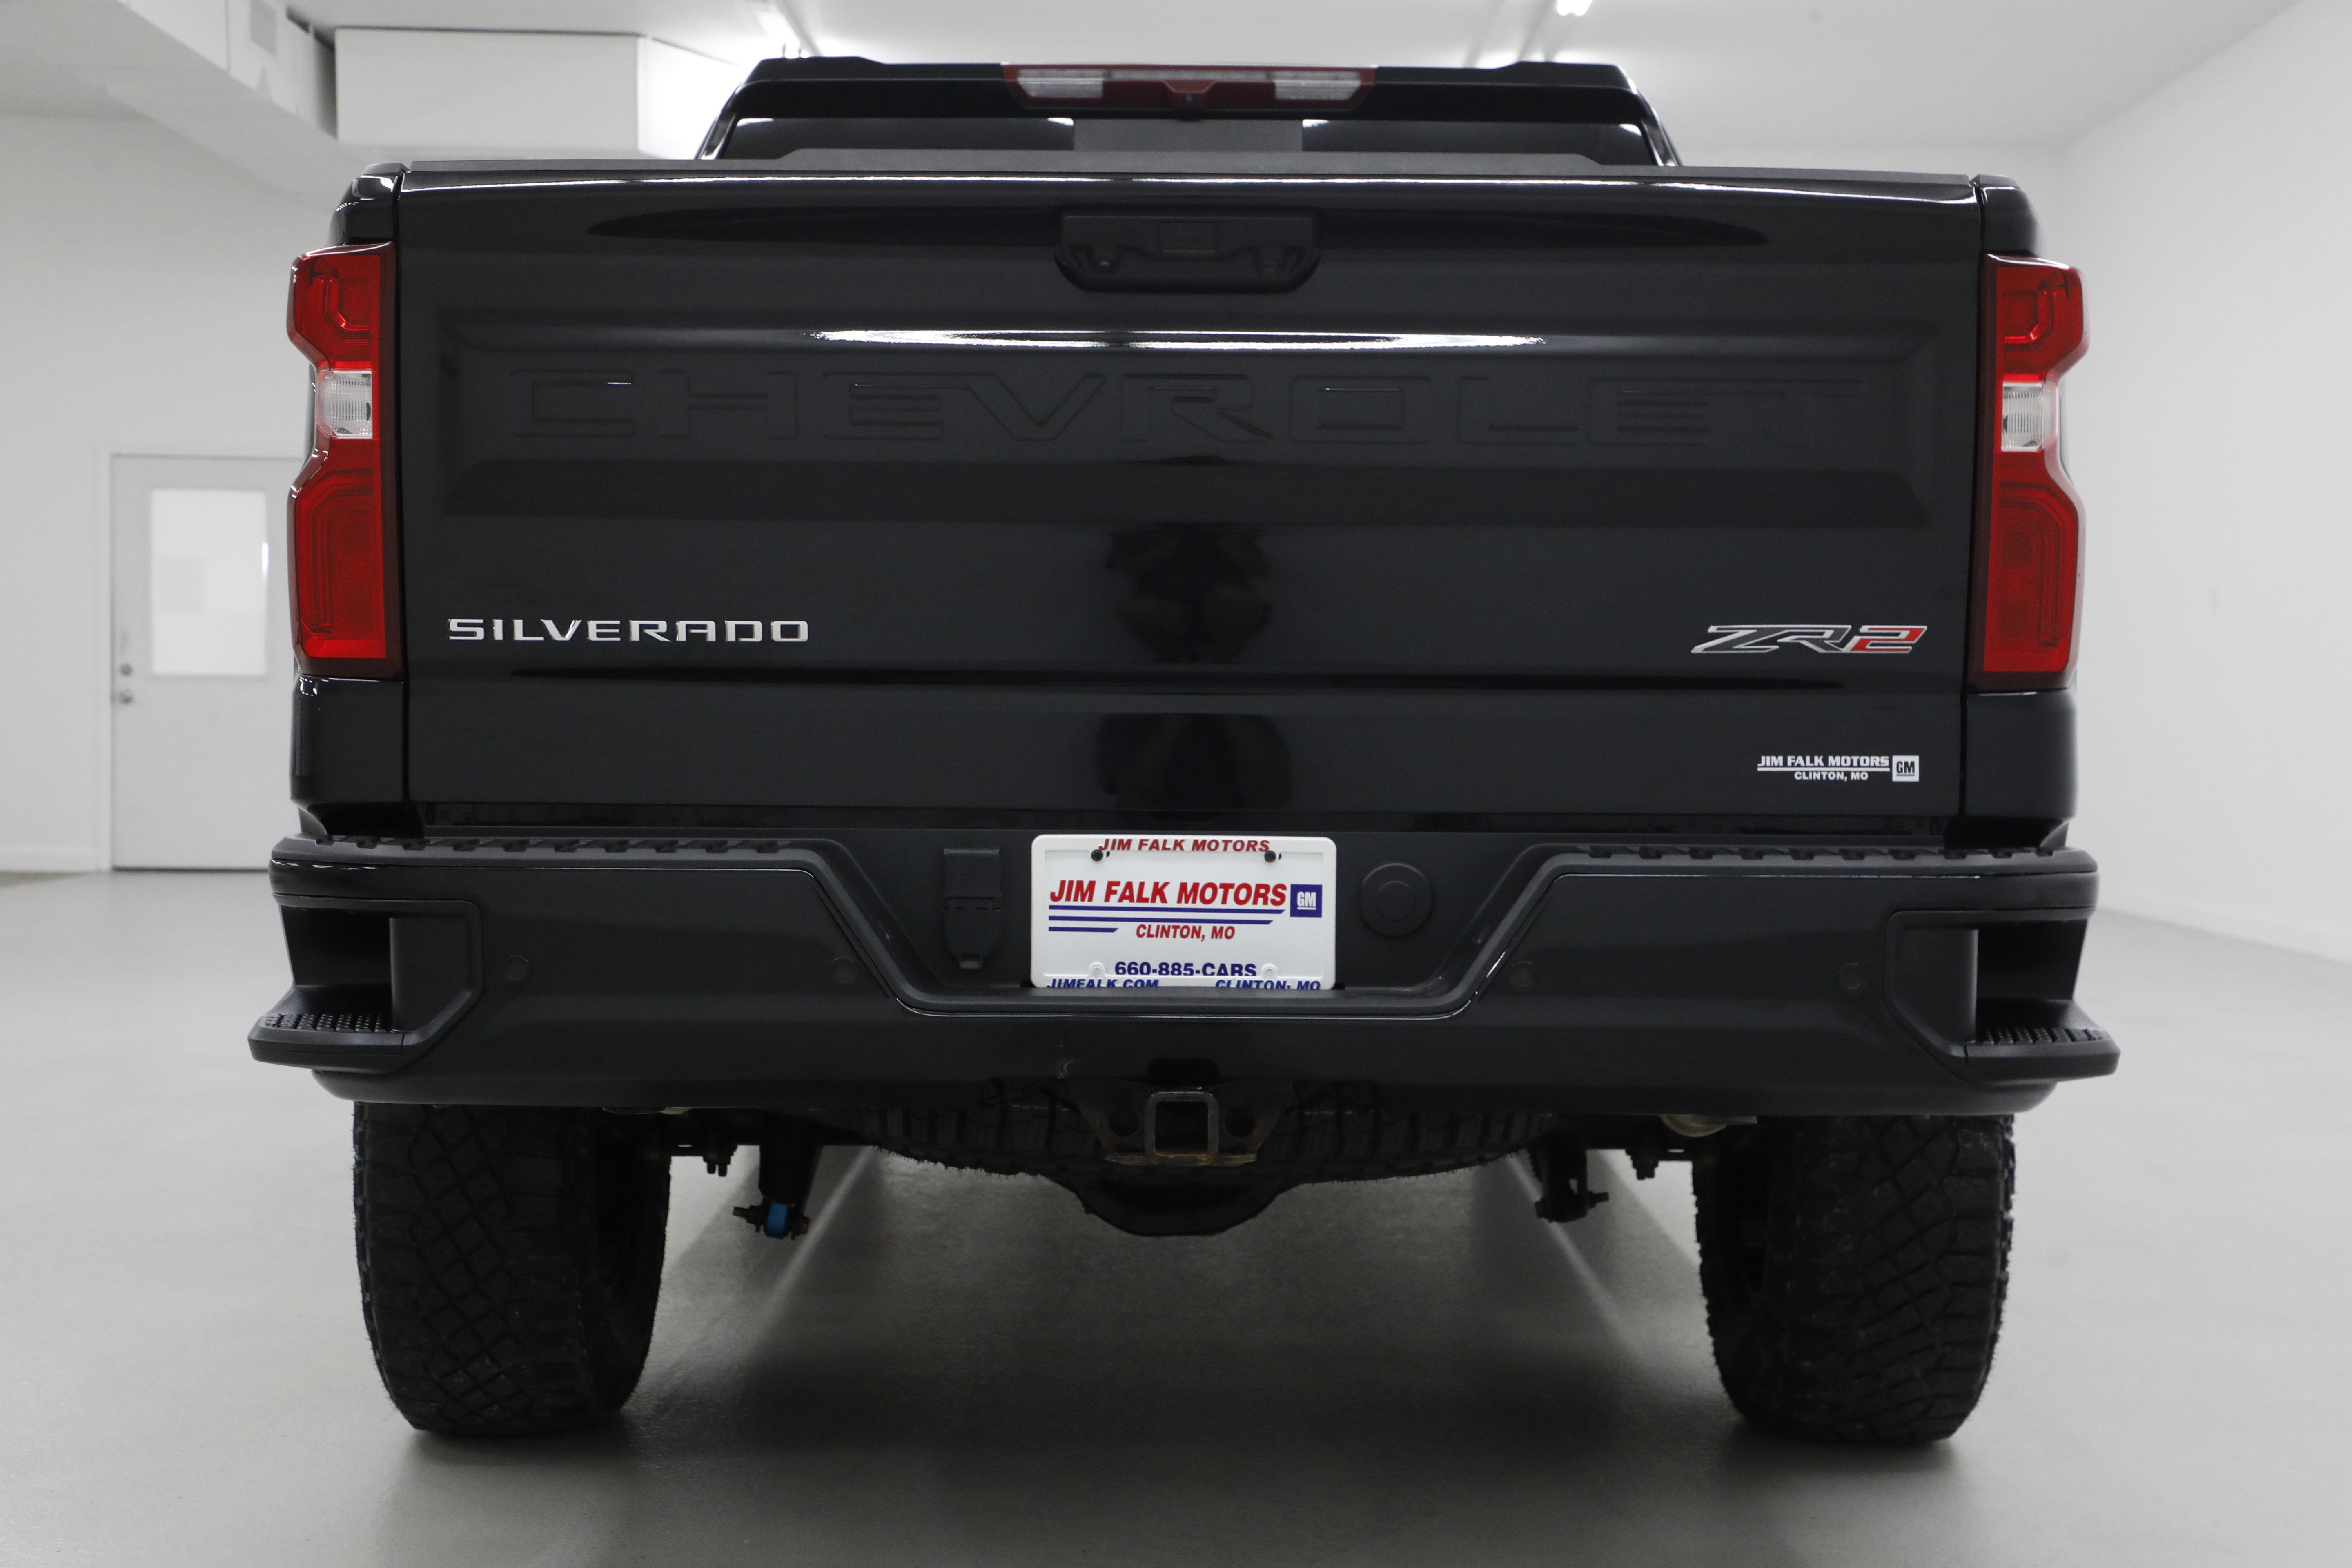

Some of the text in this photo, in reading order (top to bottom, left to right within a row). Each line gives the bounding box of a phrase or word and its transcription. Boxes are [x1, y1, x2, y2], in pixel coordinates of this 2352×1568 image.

[510, 370, 1864, 447] CHEVROLET
[448, 619, 809, 642] SILVERADO
[1691, 625, 1927, 653] ZR2
[1757, 756, 1889, 767] JIM FALK MOTORS
[1896, 761, 1915, 773] GM
[1794, 772, 1869, 782] CLINTON, MO
[1099, 839, 1270, 852] JIM FALK MOTORS
[1050, 880, 1287, 906] JIM FALK MOTORS
[1297, 891, 1317, 907] GM
[1136, 924, 1235, 941] CLINTON, MO
[1115, 962, 1256, 976] 660-885-CARS
[1047, 978, 1159, 988] JIMFALKCOM
[1296, 981, 1321, 990] MO
